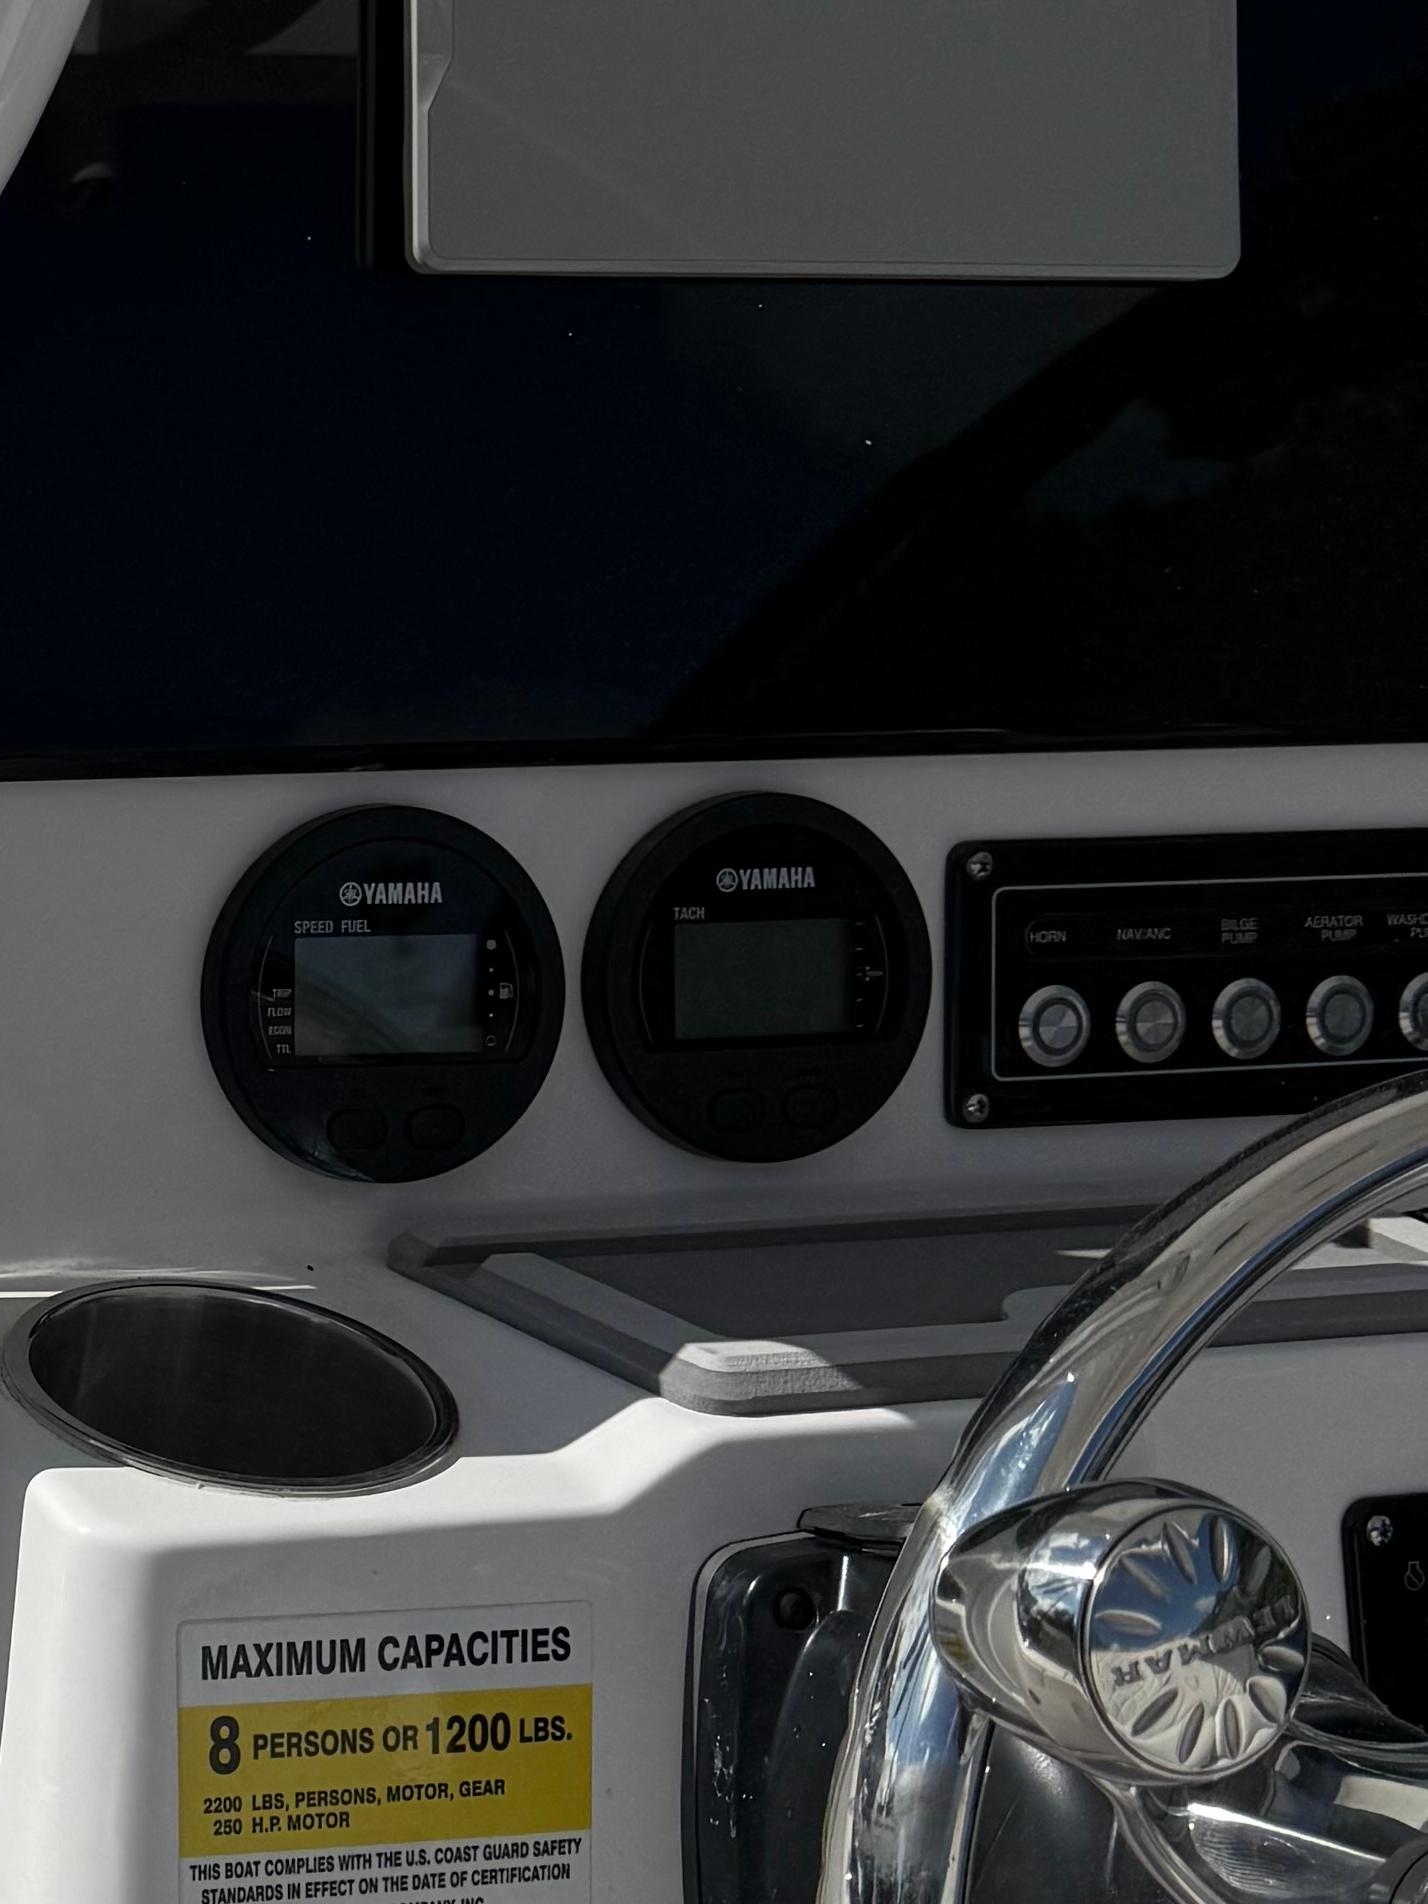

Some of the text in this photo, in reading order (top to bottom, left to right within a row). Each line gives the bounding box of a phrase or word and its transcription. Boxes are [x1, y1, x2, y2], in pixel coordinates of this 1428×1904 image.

[740, 866, 817, 891] YAMAHA
[363, 881, 443, 905] YAMAHA
[673, 906, 706, 920] TACH
[1304, 914, 1364, 928] AERATOR
[294, 919, 372, 935] SPEED FUEL
[1030, 930, 1067, 943] HORN
[200, 1626, 572, 1681] MAXIMUM CAPACITIES
[208, 1712, 573, 1775] 8 PERSONS OR 1200 LBS.
[203, 1796, 242, 1814] 2200
[295, 1787, 382, 1810] PERSONS,
[386, 1784, 454, 1803] MOTOR,
[458, 1779, 505, 1798] GEAR
[213, 1812, 350, 1836] 250 H.P. MOTOR
[190, 1838, 582, 1881] THIS BOAT COMPLIES WITH THE U.S. COAST GUARD SAFETY
[287, 1883, 301, 1899] IN
[305, 1880, 354, 1898] EFFECT
[358, 1877, 379, 1894] ON
[382, 1875, 408, 1893] THE
[412, 1873, 447, 1890] DATE
[450, 1870, 467, 1887] OF
[471, 1863, 570, 1886] CERTIFICATION
